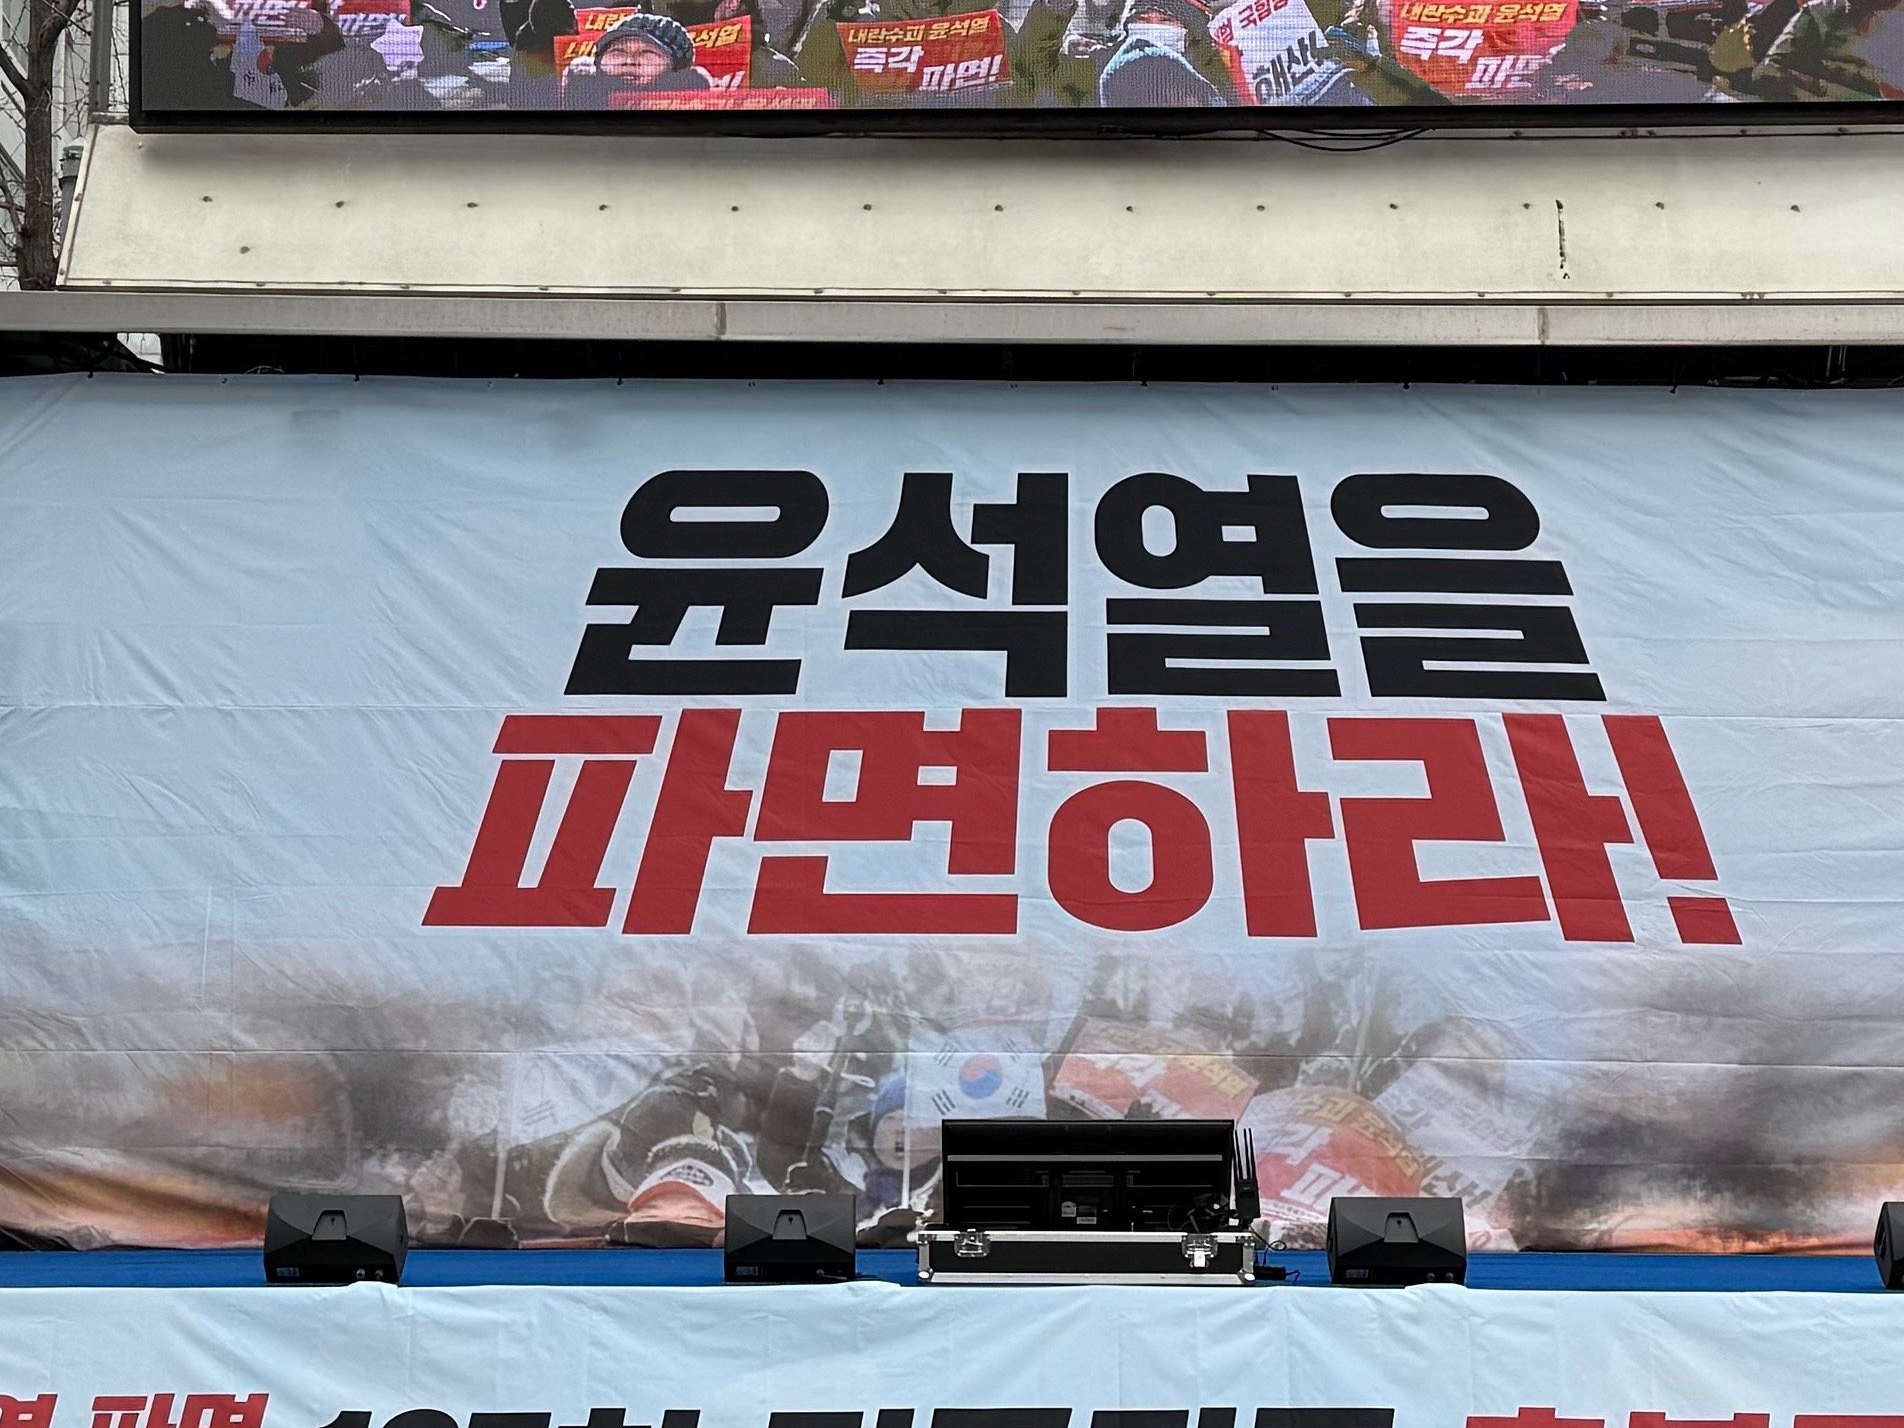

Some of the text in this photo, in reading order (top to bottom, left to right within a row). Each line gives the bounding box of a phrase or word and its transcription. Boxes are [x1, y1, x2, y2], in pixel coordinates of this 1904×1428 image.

[1399, 2, 1568, 23] 내란수괴 윤석열
[693, 22, 742, 50] 석열
[846, 15, 992, 46] 내란수괴 윤석열
[1399, 26, 1485, 64] 즉각
[852, 46, 926, 74] 즉각
[918, 54, 1003, 93] 파면!
[564, 469, 1607, 701] 윤석열을
[422, 707, 1742, 945] 파면하라!
